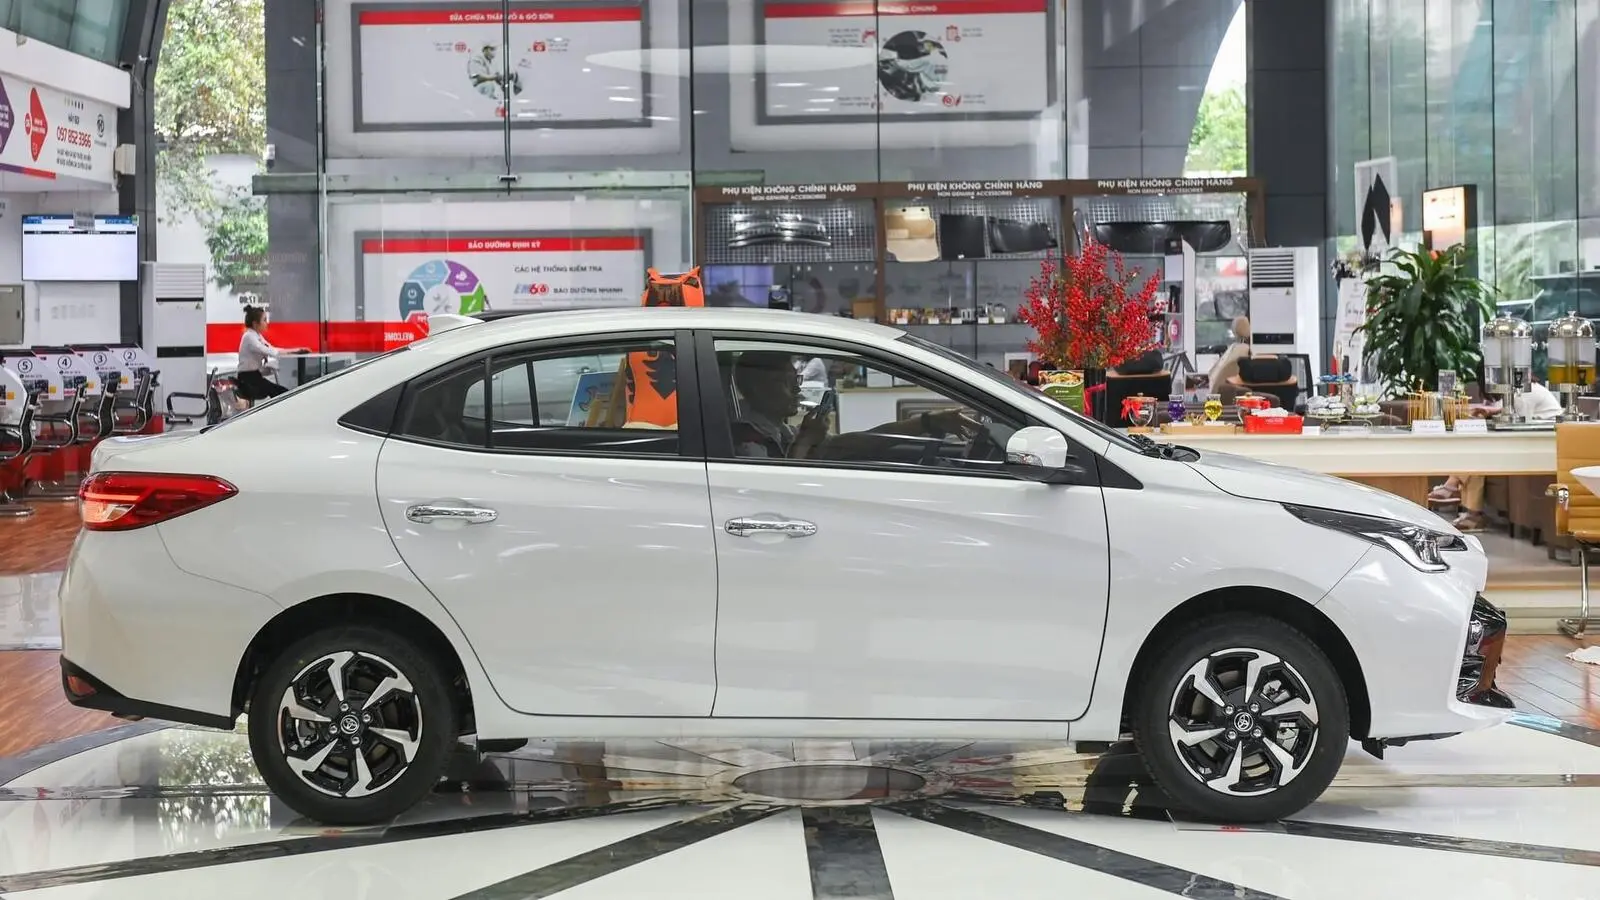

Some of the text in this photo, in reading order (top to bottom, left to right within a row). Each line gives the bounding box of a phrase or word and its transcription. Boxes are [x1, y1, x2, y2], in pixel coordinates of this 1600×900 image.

[519, 13, 525, 21] &
[56, 126, 67, 142] 097
[68, 129, 78, 145] 852
[907, 180, 1043, 192] PHỤ KIỆN KHÔNG CHÍNH HÃNG
[1097, 177, 1233, 189] PHỤ KIỆN KHÔNG CHÍNH HÃNG
[722, 183, 857, 196] PHỤ KIỆN KHÔNG CHÍNH HÃNG
[467, 240, 483, 249] BẢO
[514, 264, 603, 274] CÁC HỆ THỐNG KIỂM TRA
[553, 286, 569, 294] BẢO
[570, 286, 597, 294] DƯỠNG
